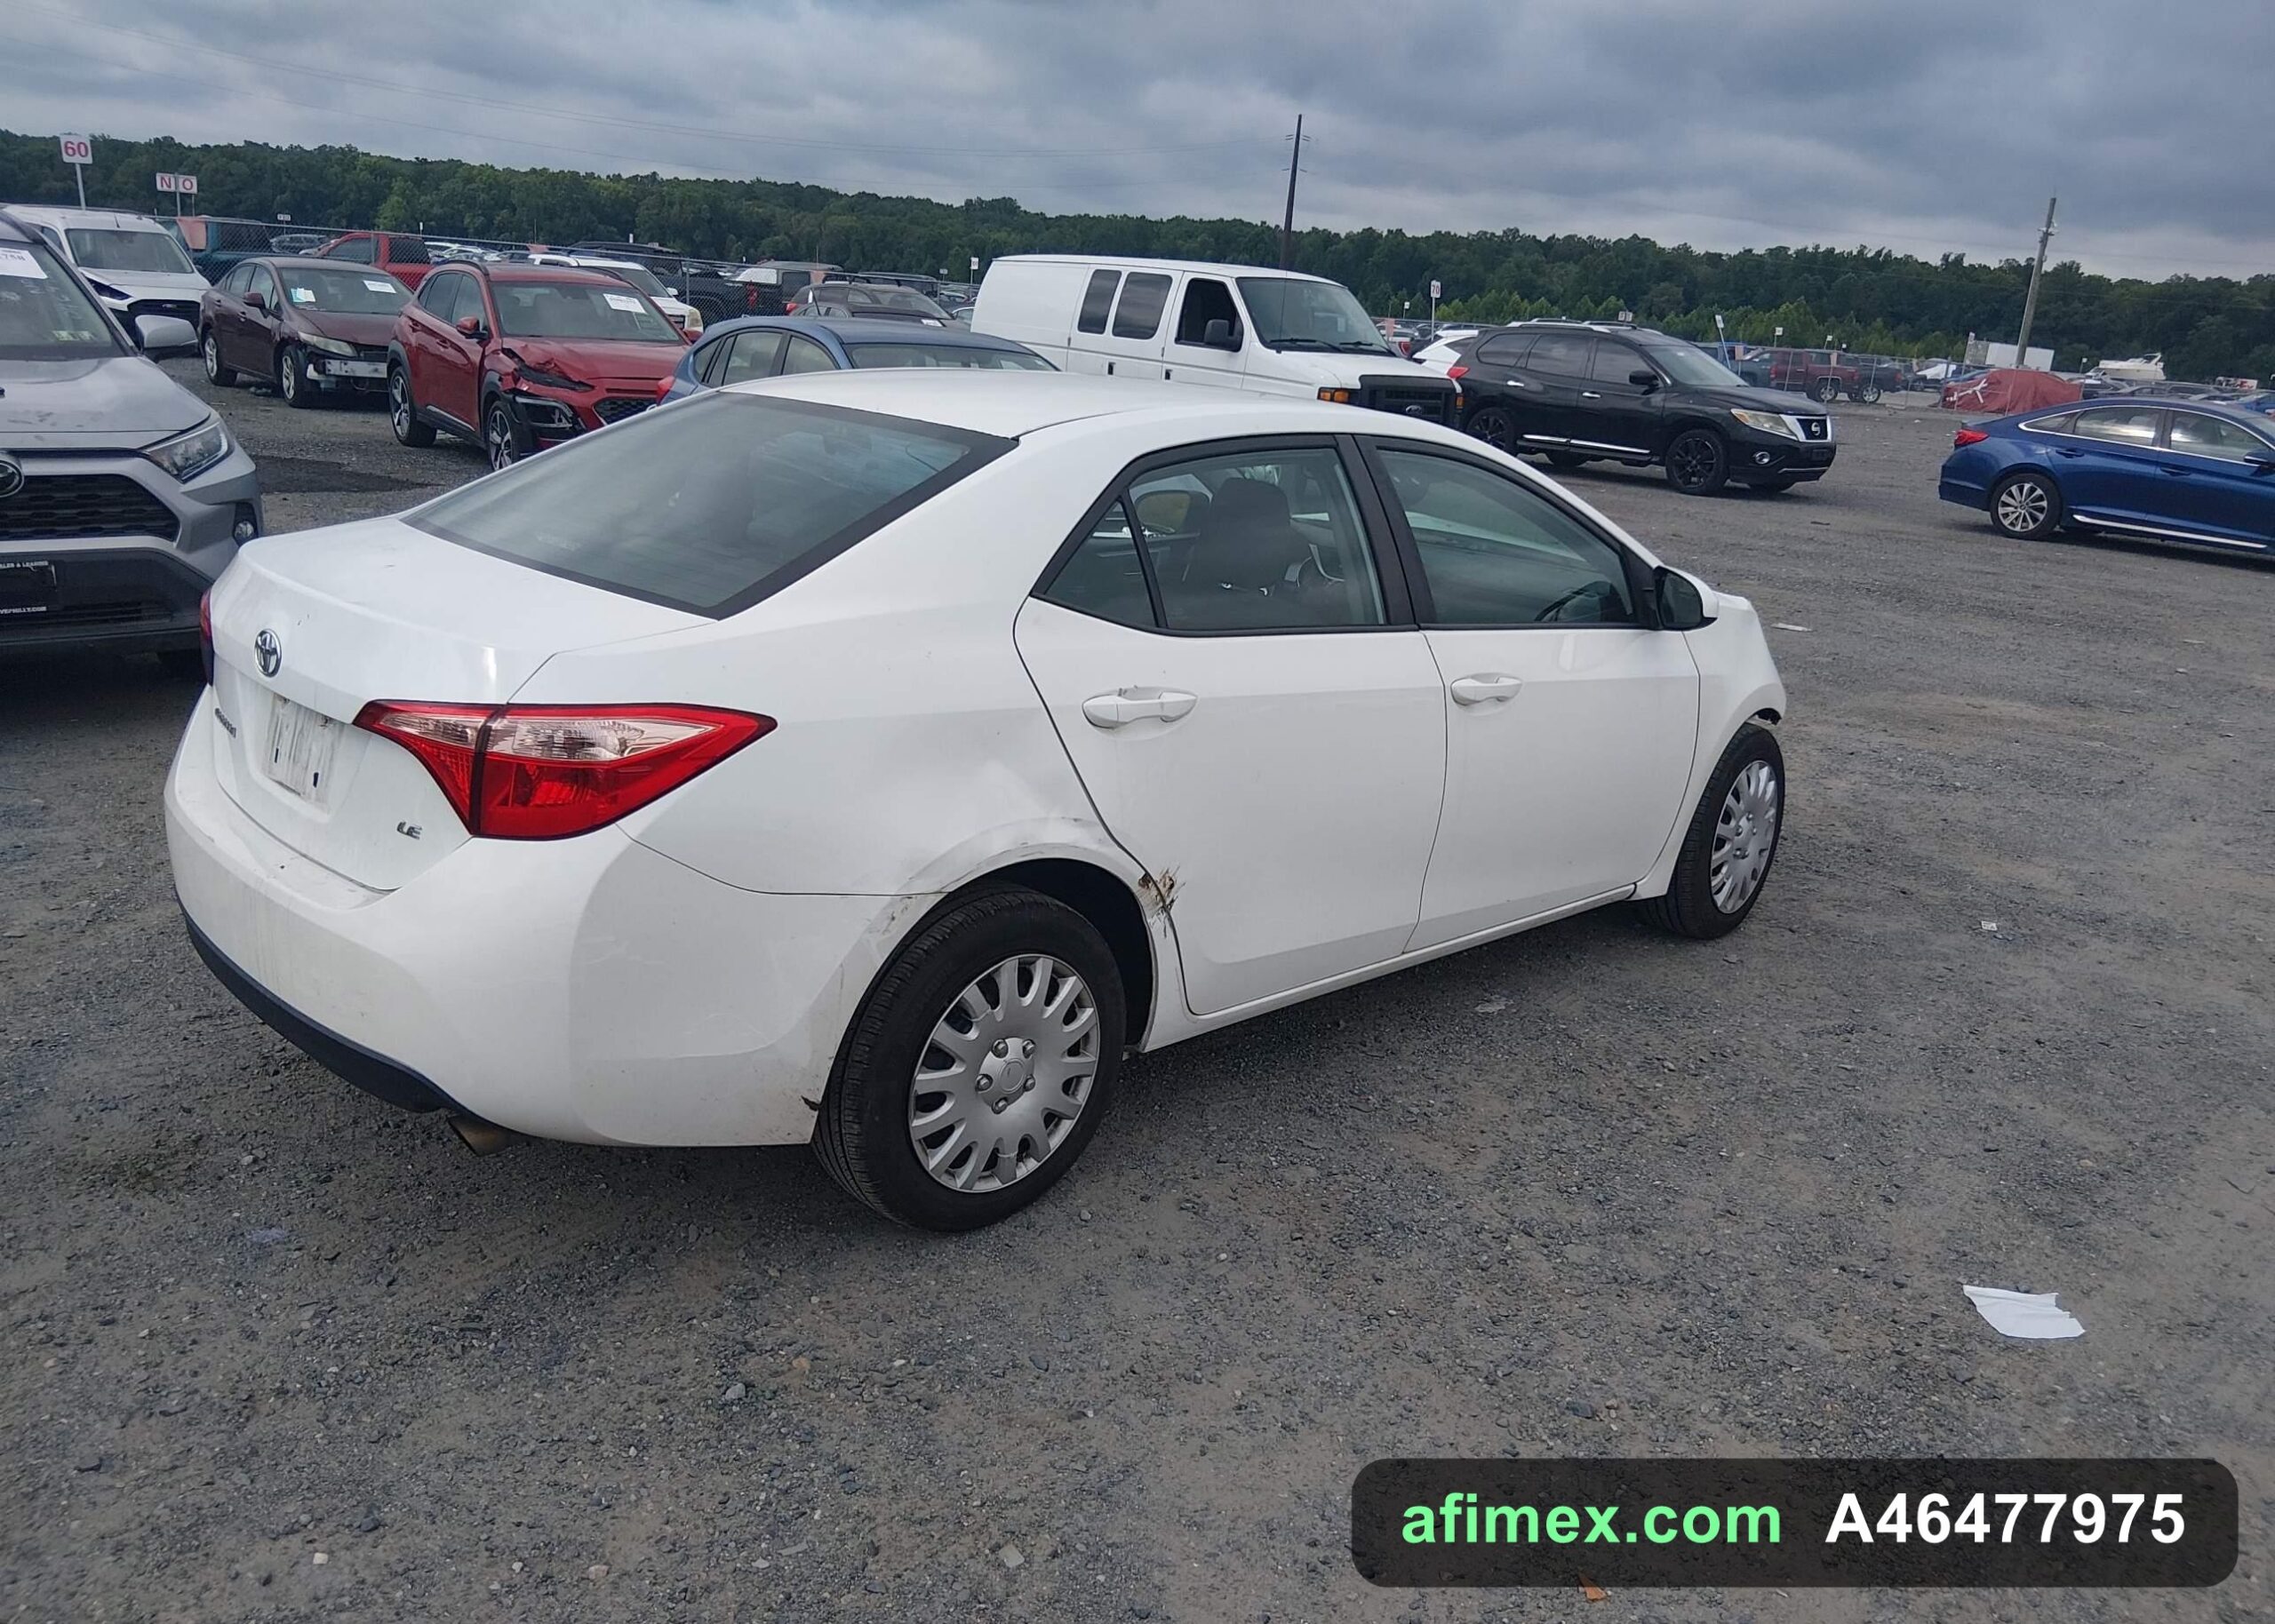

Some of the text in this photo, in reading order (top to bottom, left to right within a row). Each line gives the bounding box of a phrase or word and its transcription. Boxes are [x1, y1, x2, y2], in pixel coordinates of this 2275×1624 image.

[64, 140, 89, 158] 60
[160, 176, 172, 189] N
[1432, 284, 1440, 295] 70
[396, 821, 422, 840] LE
